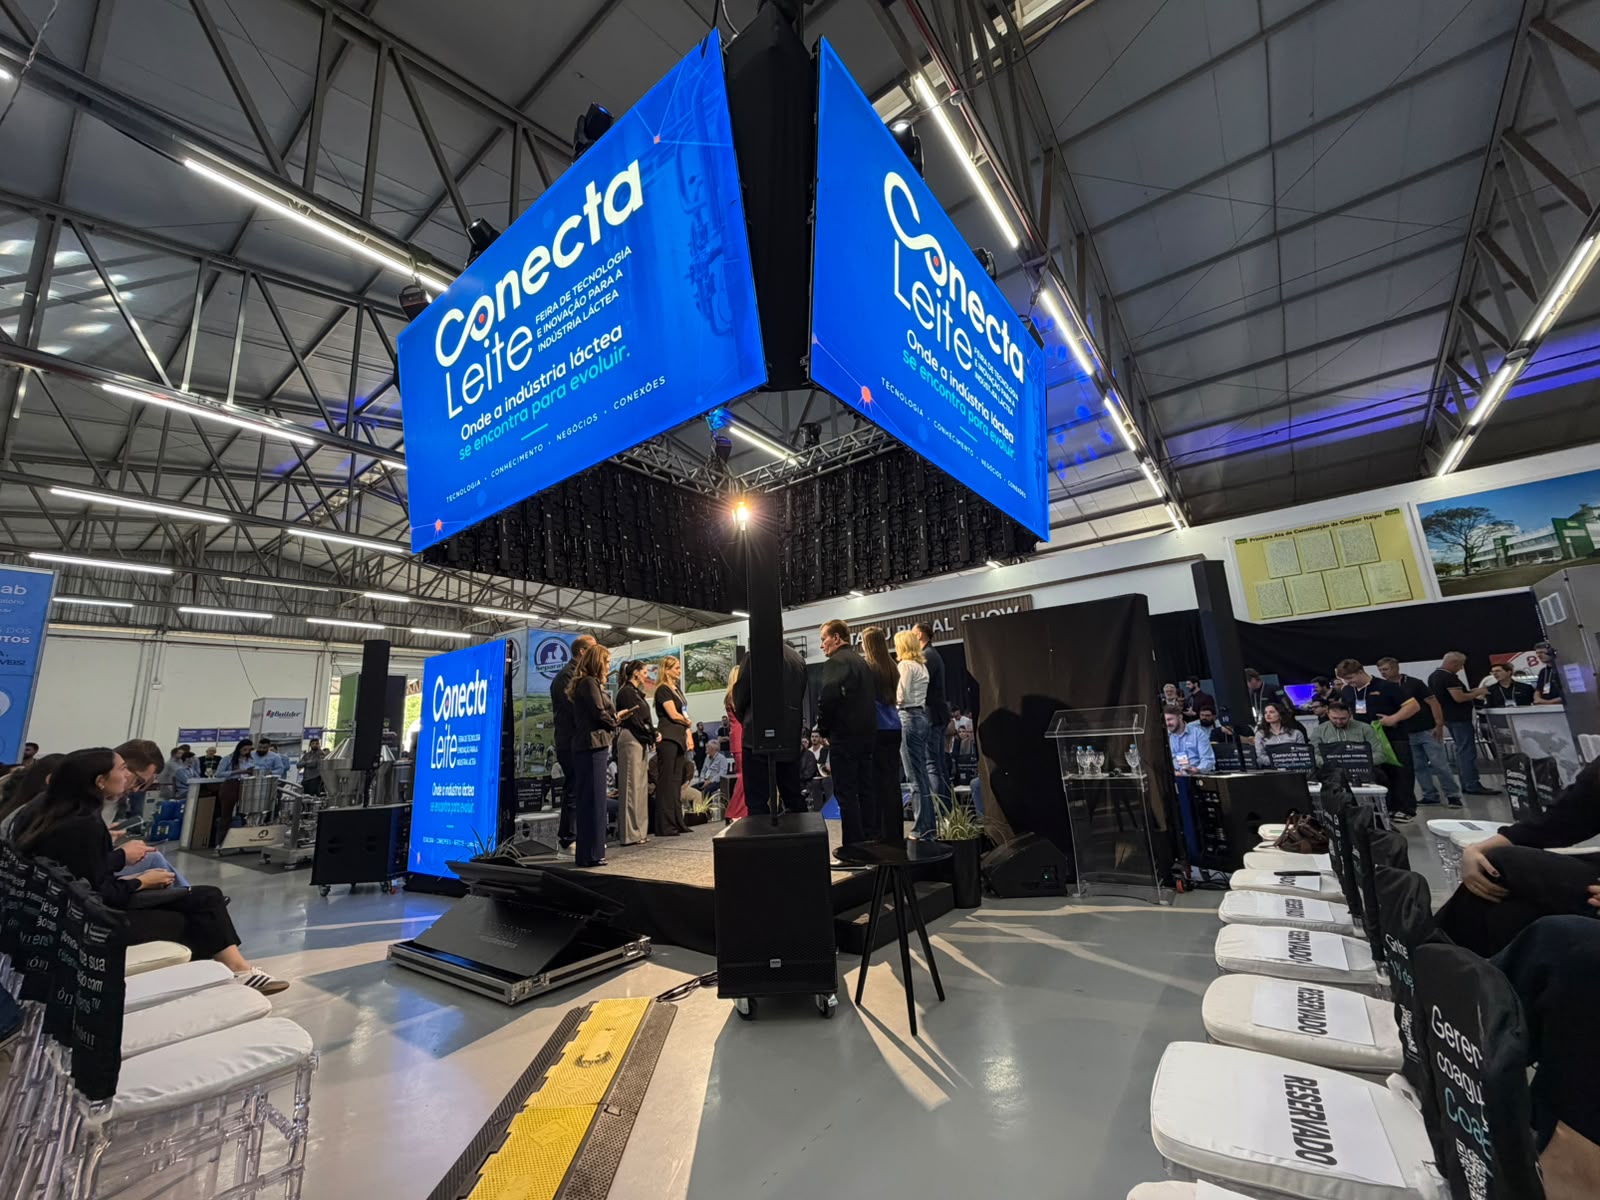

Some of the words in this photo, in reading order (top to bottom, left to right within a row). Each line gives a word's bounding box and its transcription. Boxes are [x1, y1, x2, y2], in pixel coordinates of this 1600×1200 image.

[435, 159, 644, 368] Conecta
[535, 301, 559, 325] FEIRA
[559, 290, 571, 306] DE
[572, 245, 632, 295] TECNOLOGIA
[536, 327, 542, 338] E
[543, 294, 587, 333] INOVAÇÃO
[588, 275, 614, 300] PARA
[615, 268, 623, 281] A
[884, 171, 1024, 384] Conecta
[894, 239, 972, 371] Leite
[538, 316, 582, 352] INDÚSTRIA
[582, 289, 619, 321] LÁCTEA
[446, 326, 533, 419] Leite
[459, 443, 471, 461] se
[473, 409, 529, 452] encontra
[531, 384, 567, 420] para
[570, 345, 631, 392] evoluir.
[461, 413, 492, 441] Onde
[494, 405, 502, 418] a
[504, 361, 567, 413] indústria
[569, 325, 623, 370] láctea
[881, 377, 924, 417] TECNOLOGIA
[903, 349, 917, 371] se
[920, 365, 966, 416] encontra
[968, 410, 989, 436] para
[907, 329, 939, 372] Onde
[940, 366, 948, 381] a
[949, 370, 989, 421] indústria
[991, 410, 1014, 445] láctea
[446, 479, 481, 503] TECNOLOGIA
[490, 443, 544, 478] CONHECIMENTO
[556, 413, 598, 441] NEGÓCIOS
[613, 376, 666, 410] CONEXÕES
[432, 668, 488, 723] Conecta
[430, 723, 458, 769] Leite
[1297, 986, 1329, 1036] RESERVADO
[1283, 1074, 1338, 1166] RESERVADO
